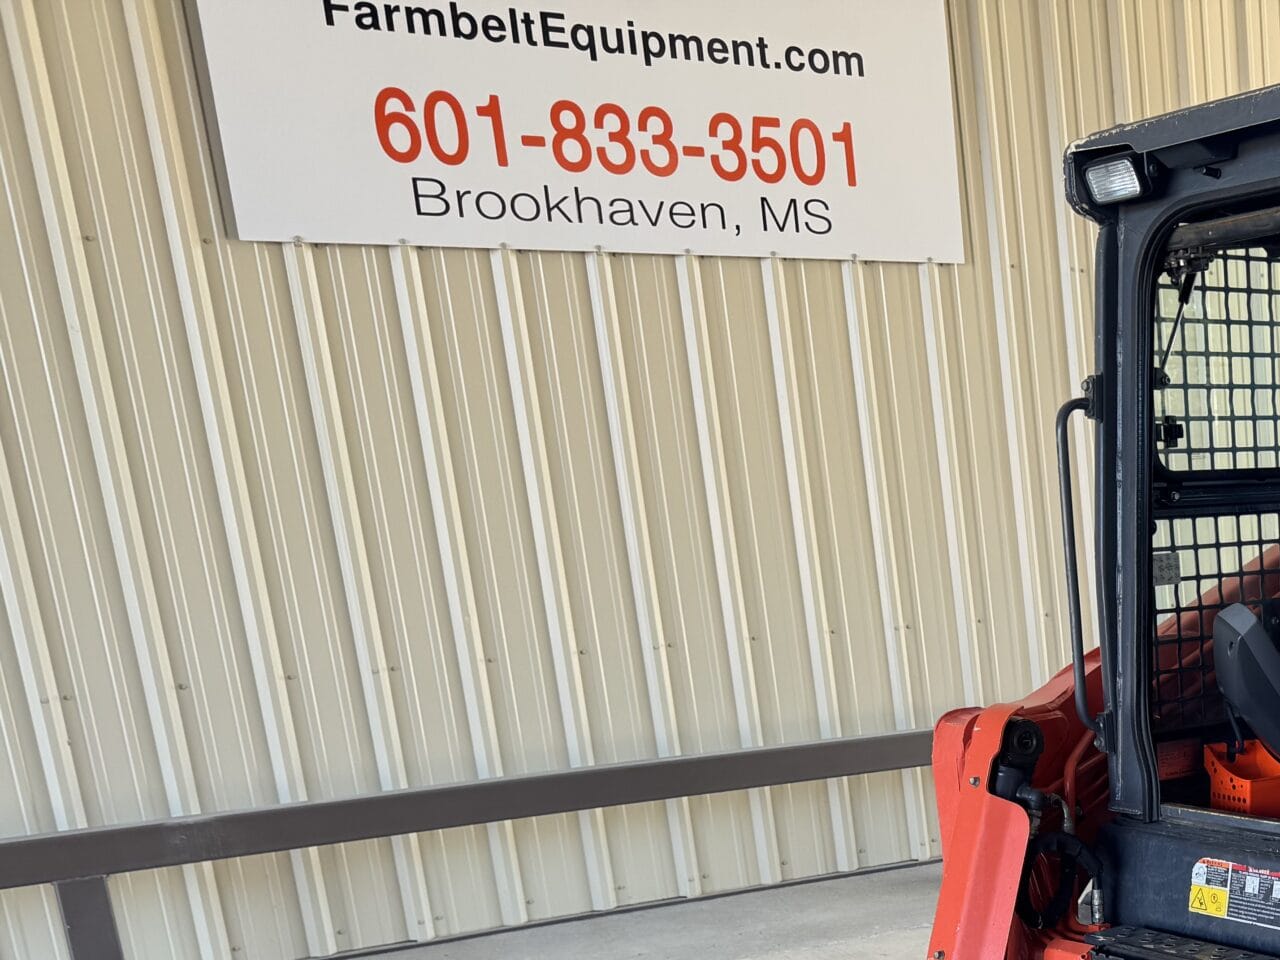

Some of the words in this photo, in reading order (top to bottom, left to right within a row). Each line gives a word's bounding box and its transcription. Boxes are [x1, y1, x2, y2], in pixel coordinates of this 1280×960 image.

[323, 0, 865, 77] FarmbeltEquipment.com
[374, 86, 857, 187] 601-833-3501
[411, 176, 742, 236] Brookhaven,
[760, 195, 833, 235] MS
